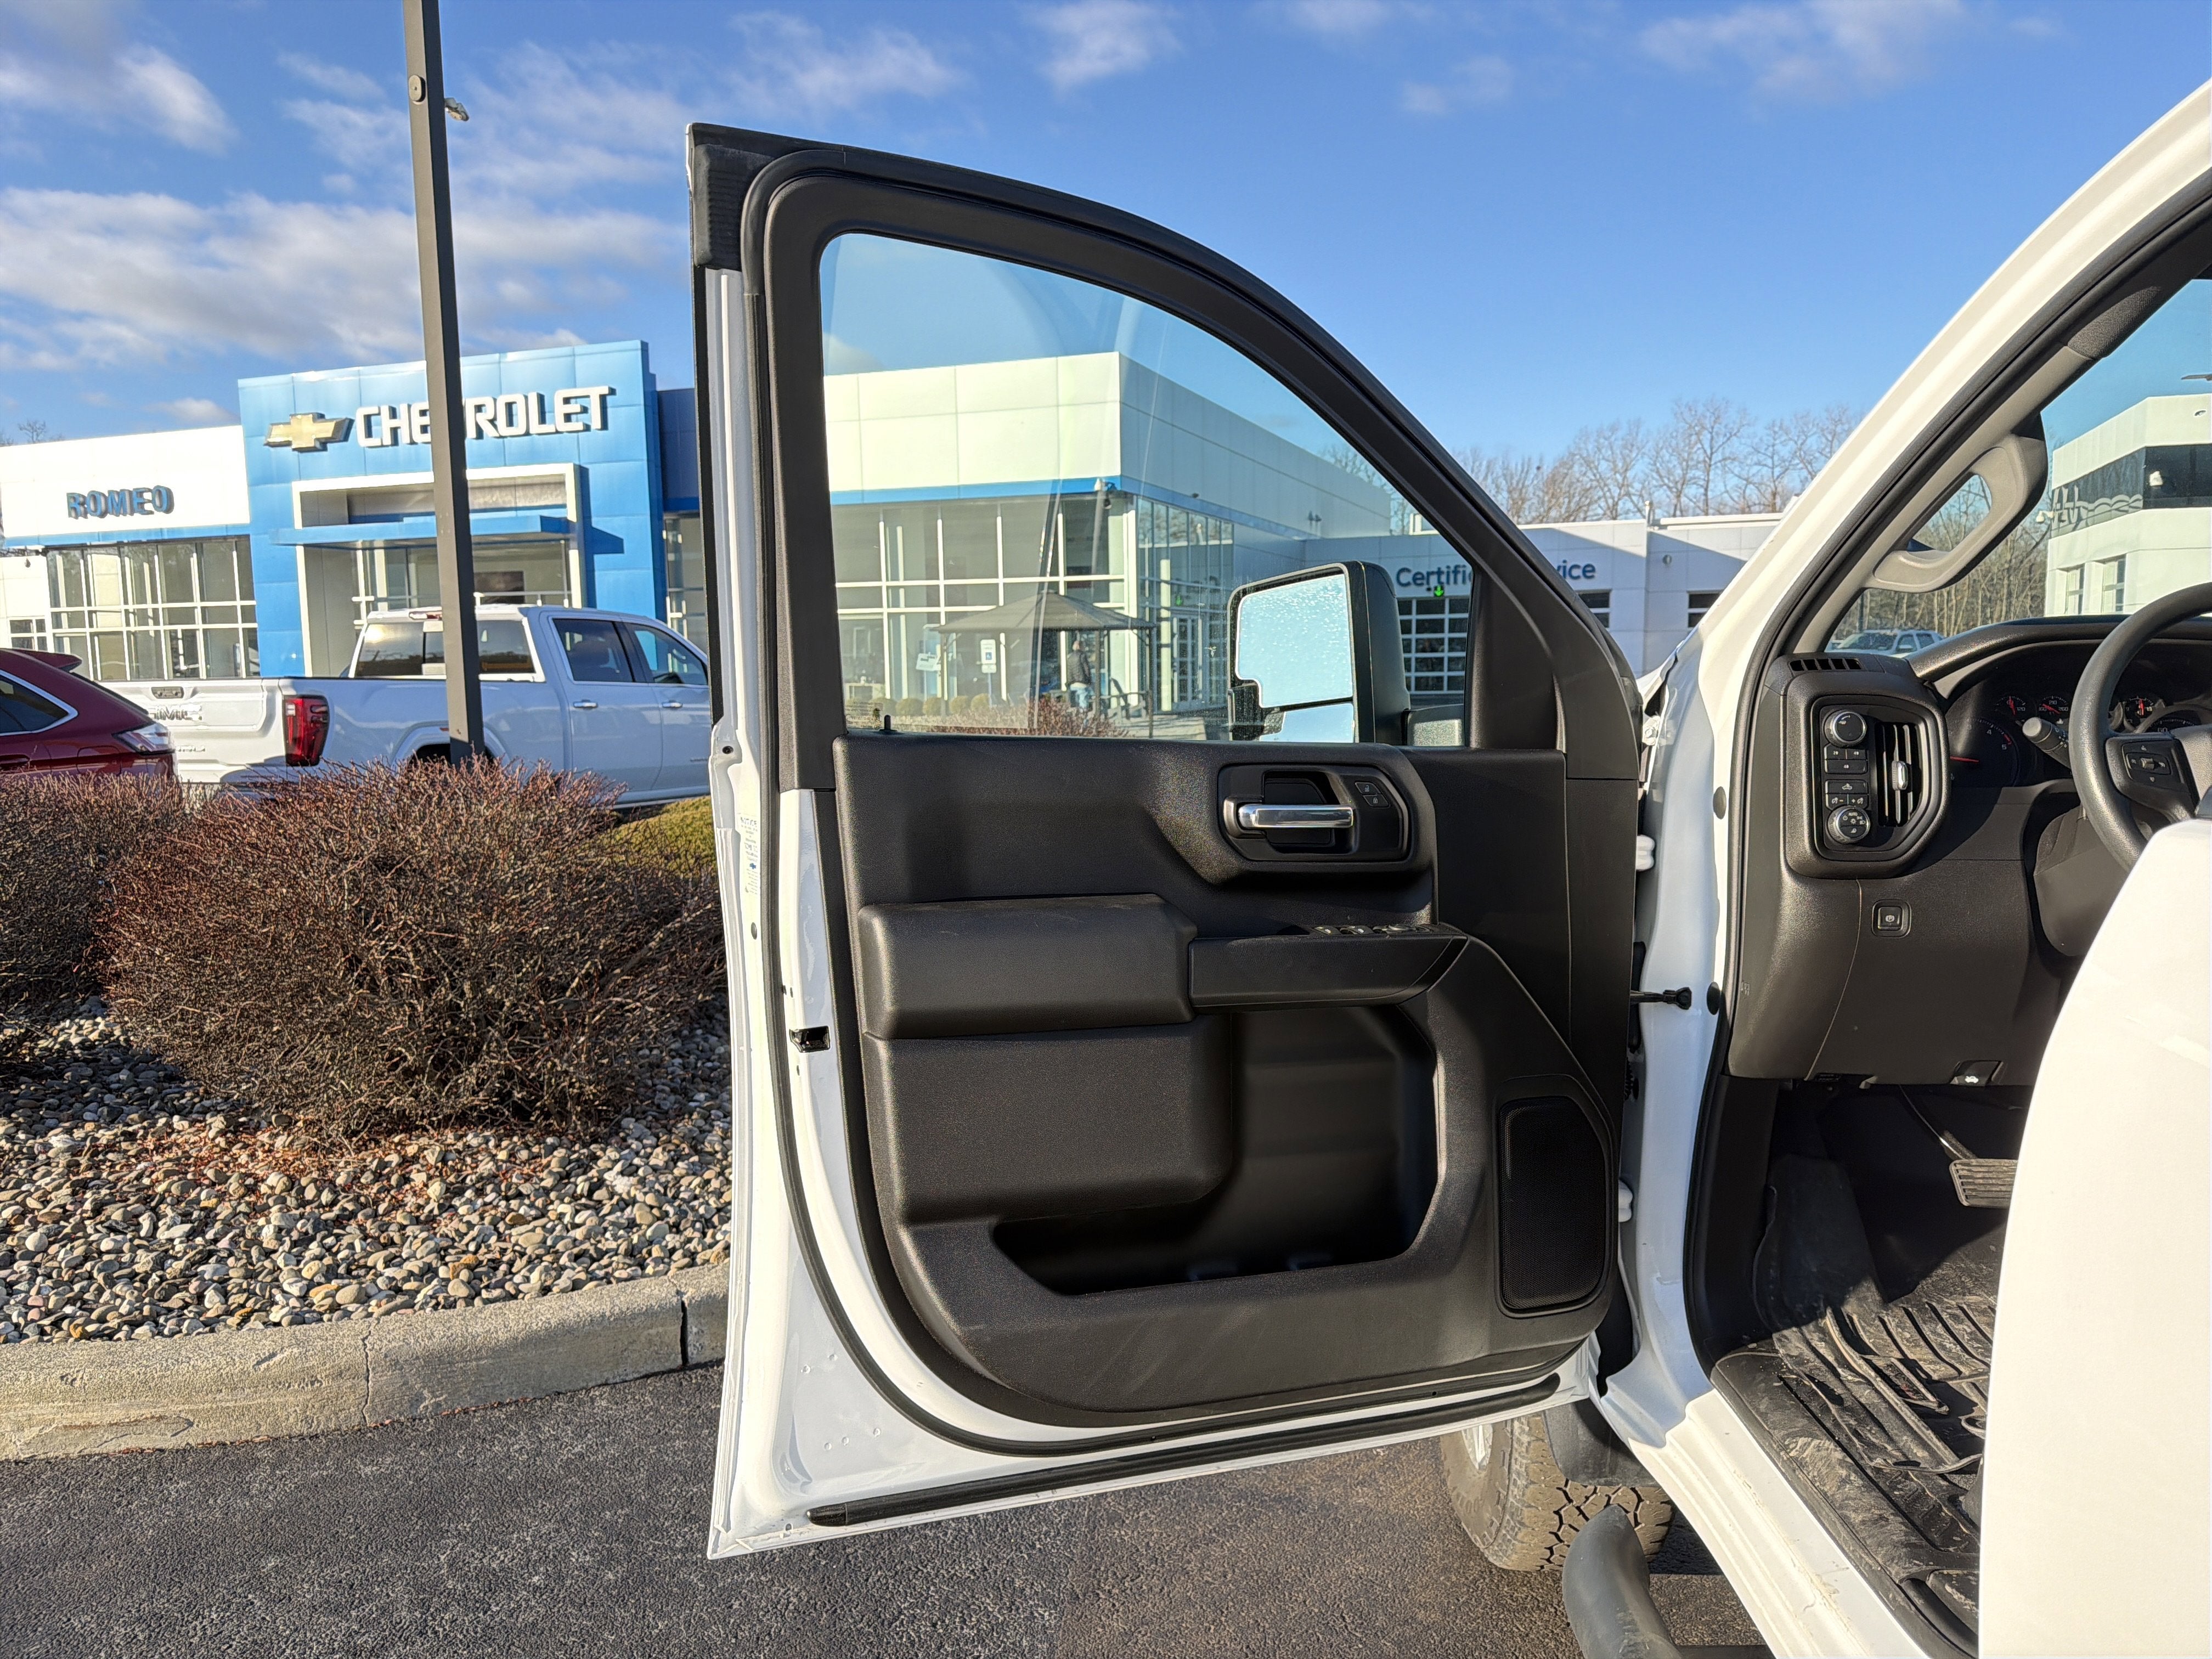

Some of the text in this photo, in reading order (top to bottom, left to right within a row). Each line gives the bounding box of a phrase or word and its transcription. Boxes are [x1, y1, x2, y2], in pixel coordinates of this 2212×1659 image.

[356, 386, 615, 448] CHEROLET
[66, 485, 174, 520] ROMEO
[1396, 565, 1472, 587] Certifi
